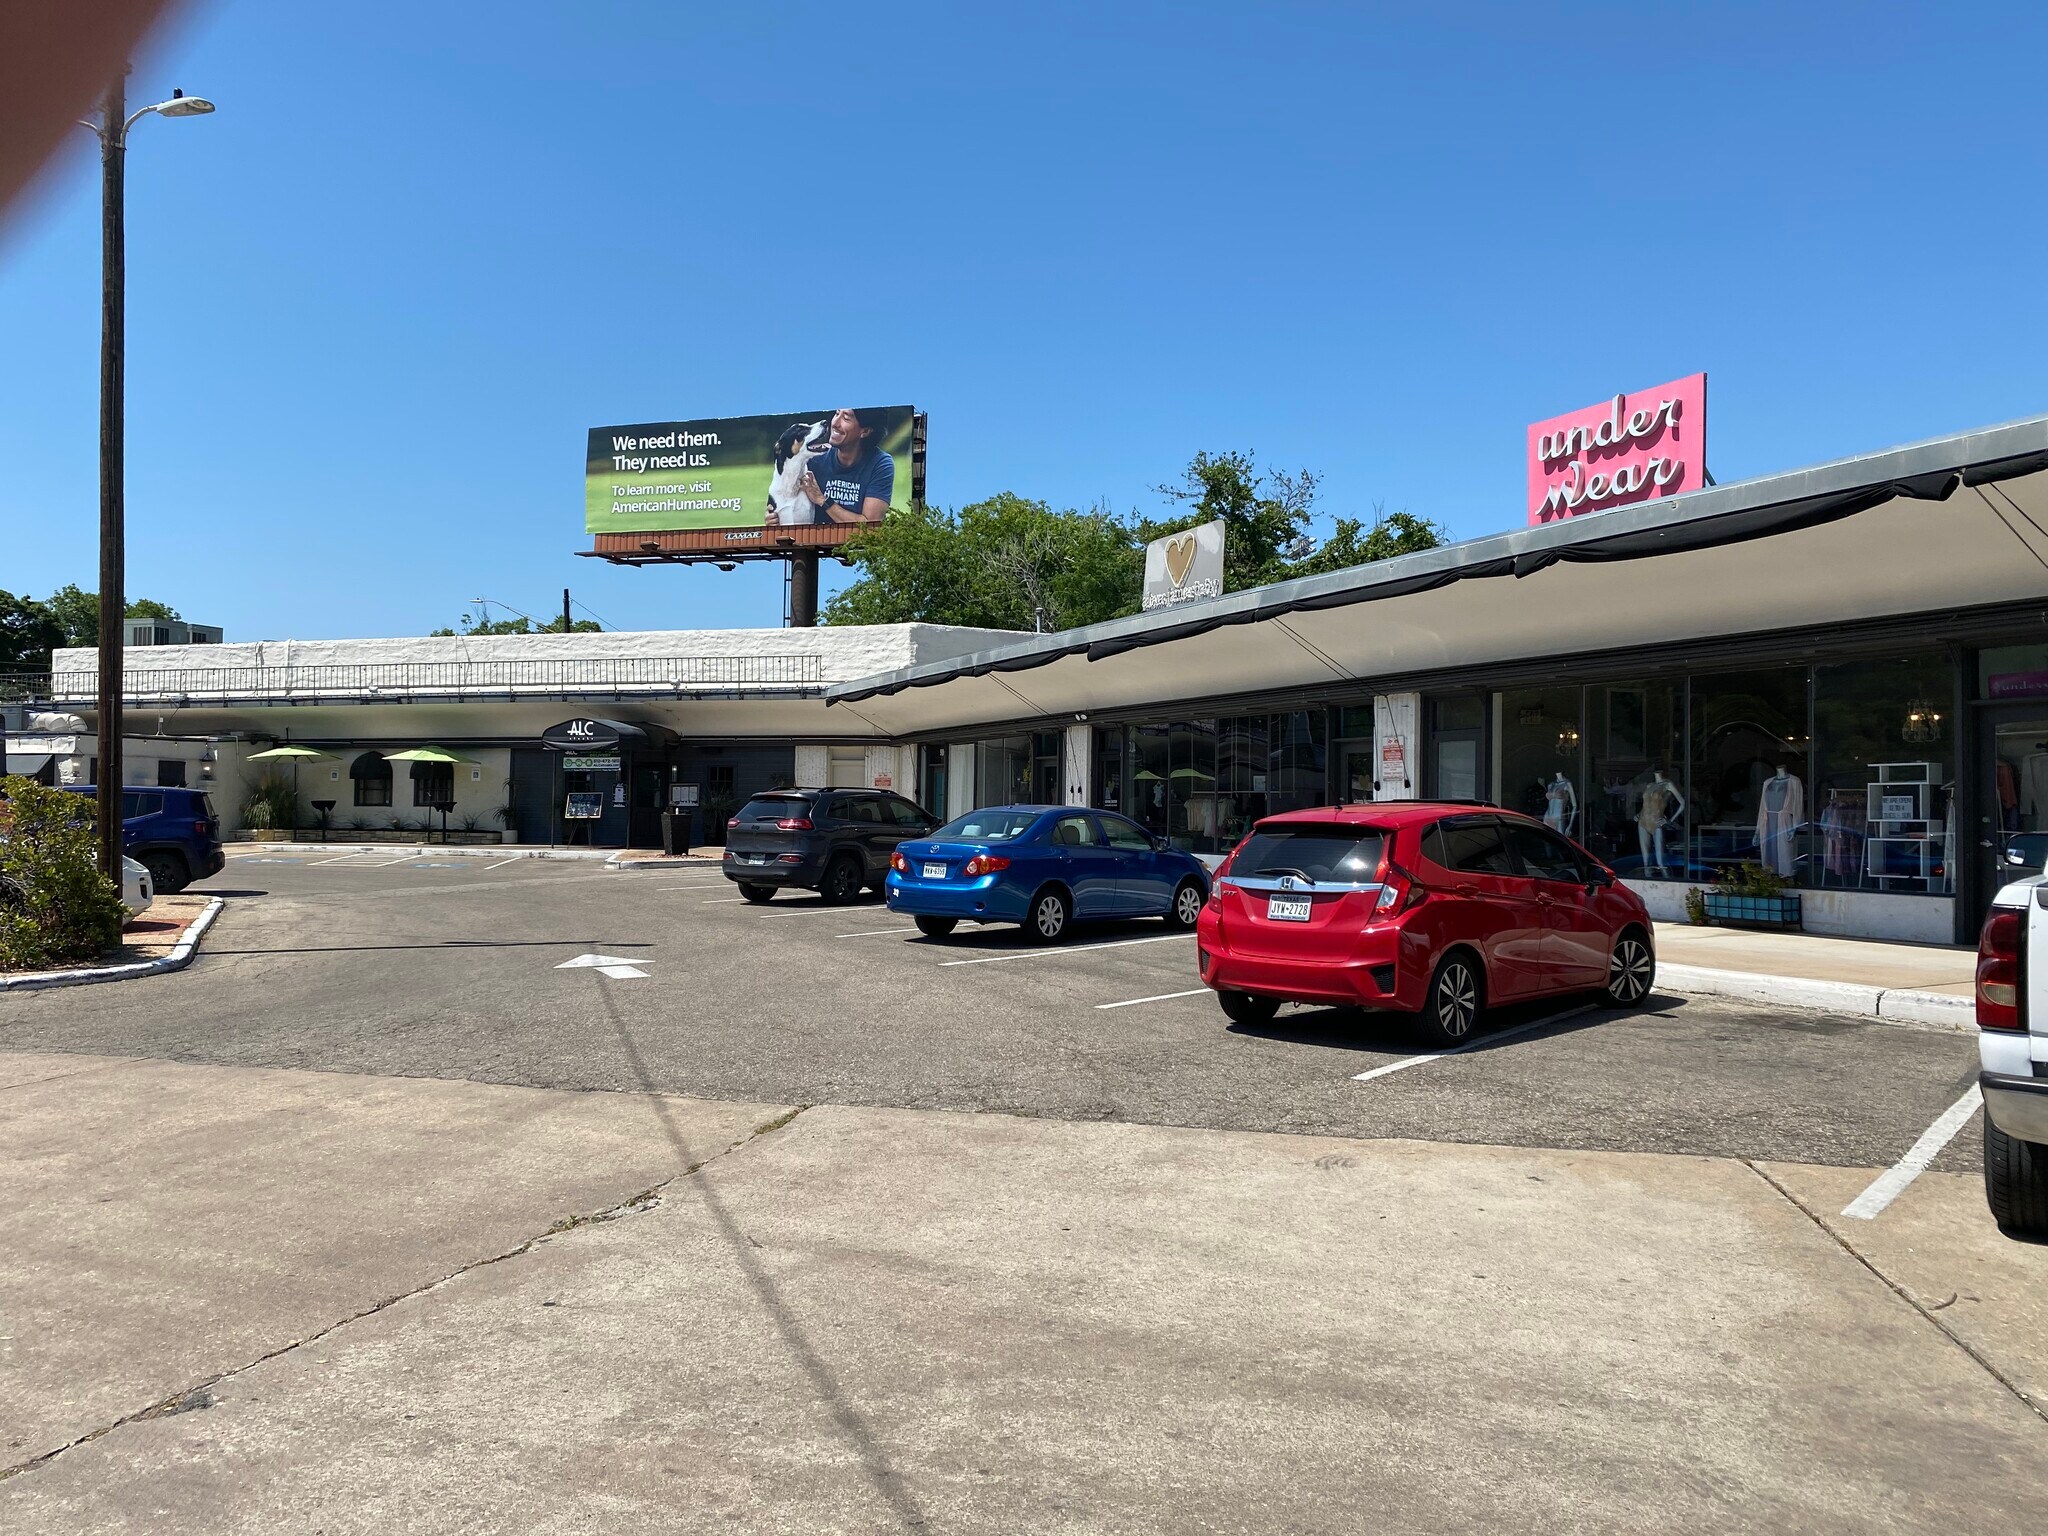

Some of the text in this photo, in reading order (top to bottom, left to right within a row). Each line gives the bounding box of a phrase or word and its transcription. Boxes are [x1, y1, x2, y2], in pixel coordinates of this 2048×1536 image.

[1537, 393, 1683, 463] under
[612, 430, 722, 451] We need them.
[612, 451, 711, 474] They need us.
[612, 481, 712, 496] To learn more, visit
[825, 480, 861, 491] AMERICAN
[824, 490, 860, 503] HUMANE
[611, 497, 742, 514] AmericanHumane.org
[726, 531, 760, 540] LAMAR
[566, 720, 594, 736] ALC
